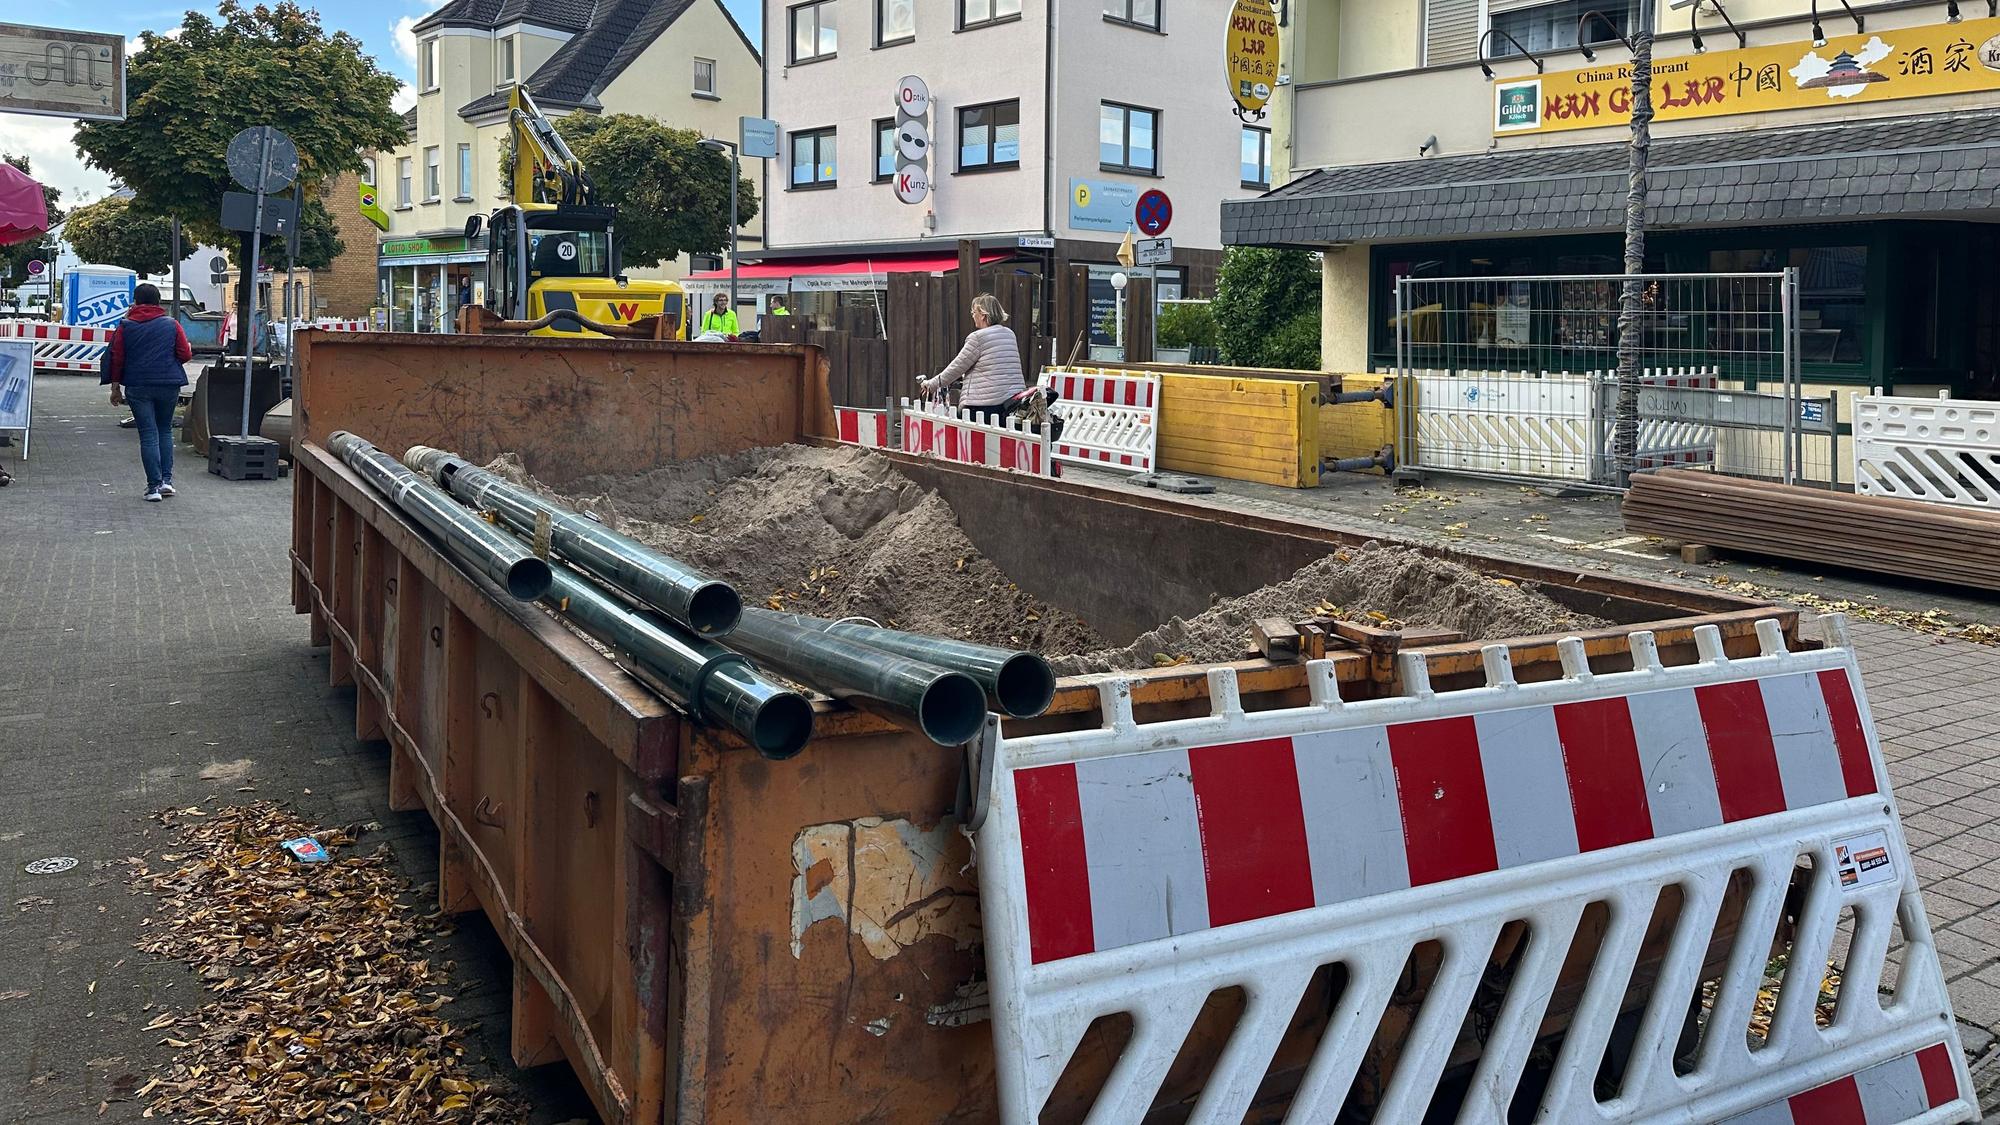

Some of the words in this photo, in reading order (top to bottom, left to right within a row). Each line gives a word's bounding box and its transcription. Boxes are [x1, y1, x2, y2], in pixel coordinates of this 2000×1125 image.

[1238, 2, 1272, 17] Restaurant
[1241, 36, 1266, 56] LAR
[1576, 71, 1613, 84] China
[1618, 61, 1689, 79] Reurant
[1729, 61, 1782, 97] 中國
[1898, 38, 1975, 76] 酒家
[902, 87, 926, 103] Optik
[1544, 89, 1601, 121] HAN
[1660, 76, 1725, 110] LAR
[1501, 104, 1534, 115] Gilden
[900, 173, 926, 193] Kunz
[1079, 189, 1087, 202] P
[388, 244, 406, 254] LOTTO
[408, 242, 424, 252] SHOP
[561, 244, 573, 257] 20
